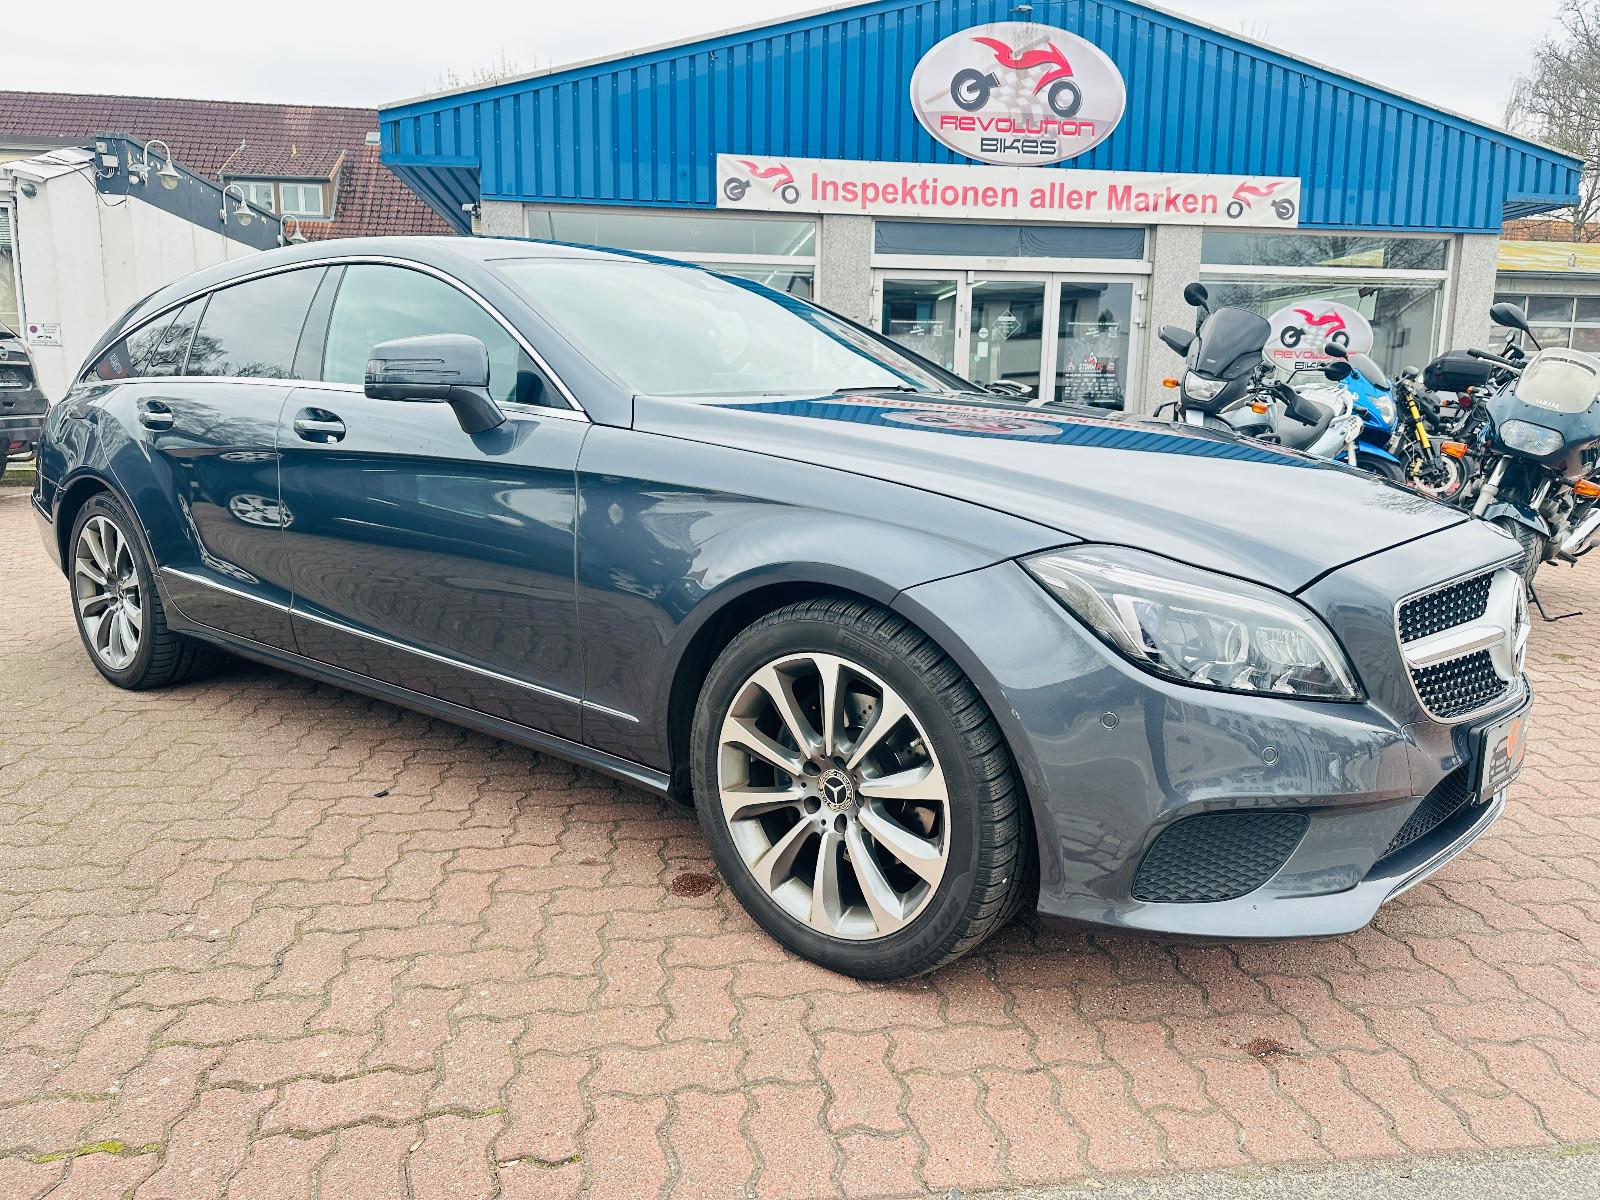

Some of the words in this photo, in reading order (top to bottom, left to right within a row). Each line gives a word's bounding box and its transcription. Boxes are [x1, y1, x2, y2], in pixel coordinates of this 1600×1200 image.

[811, 172, 1018, 209] Inspektionen
[1029, 182, 1098, 210] aller
[1107, 184, 1218, 214] Marken
